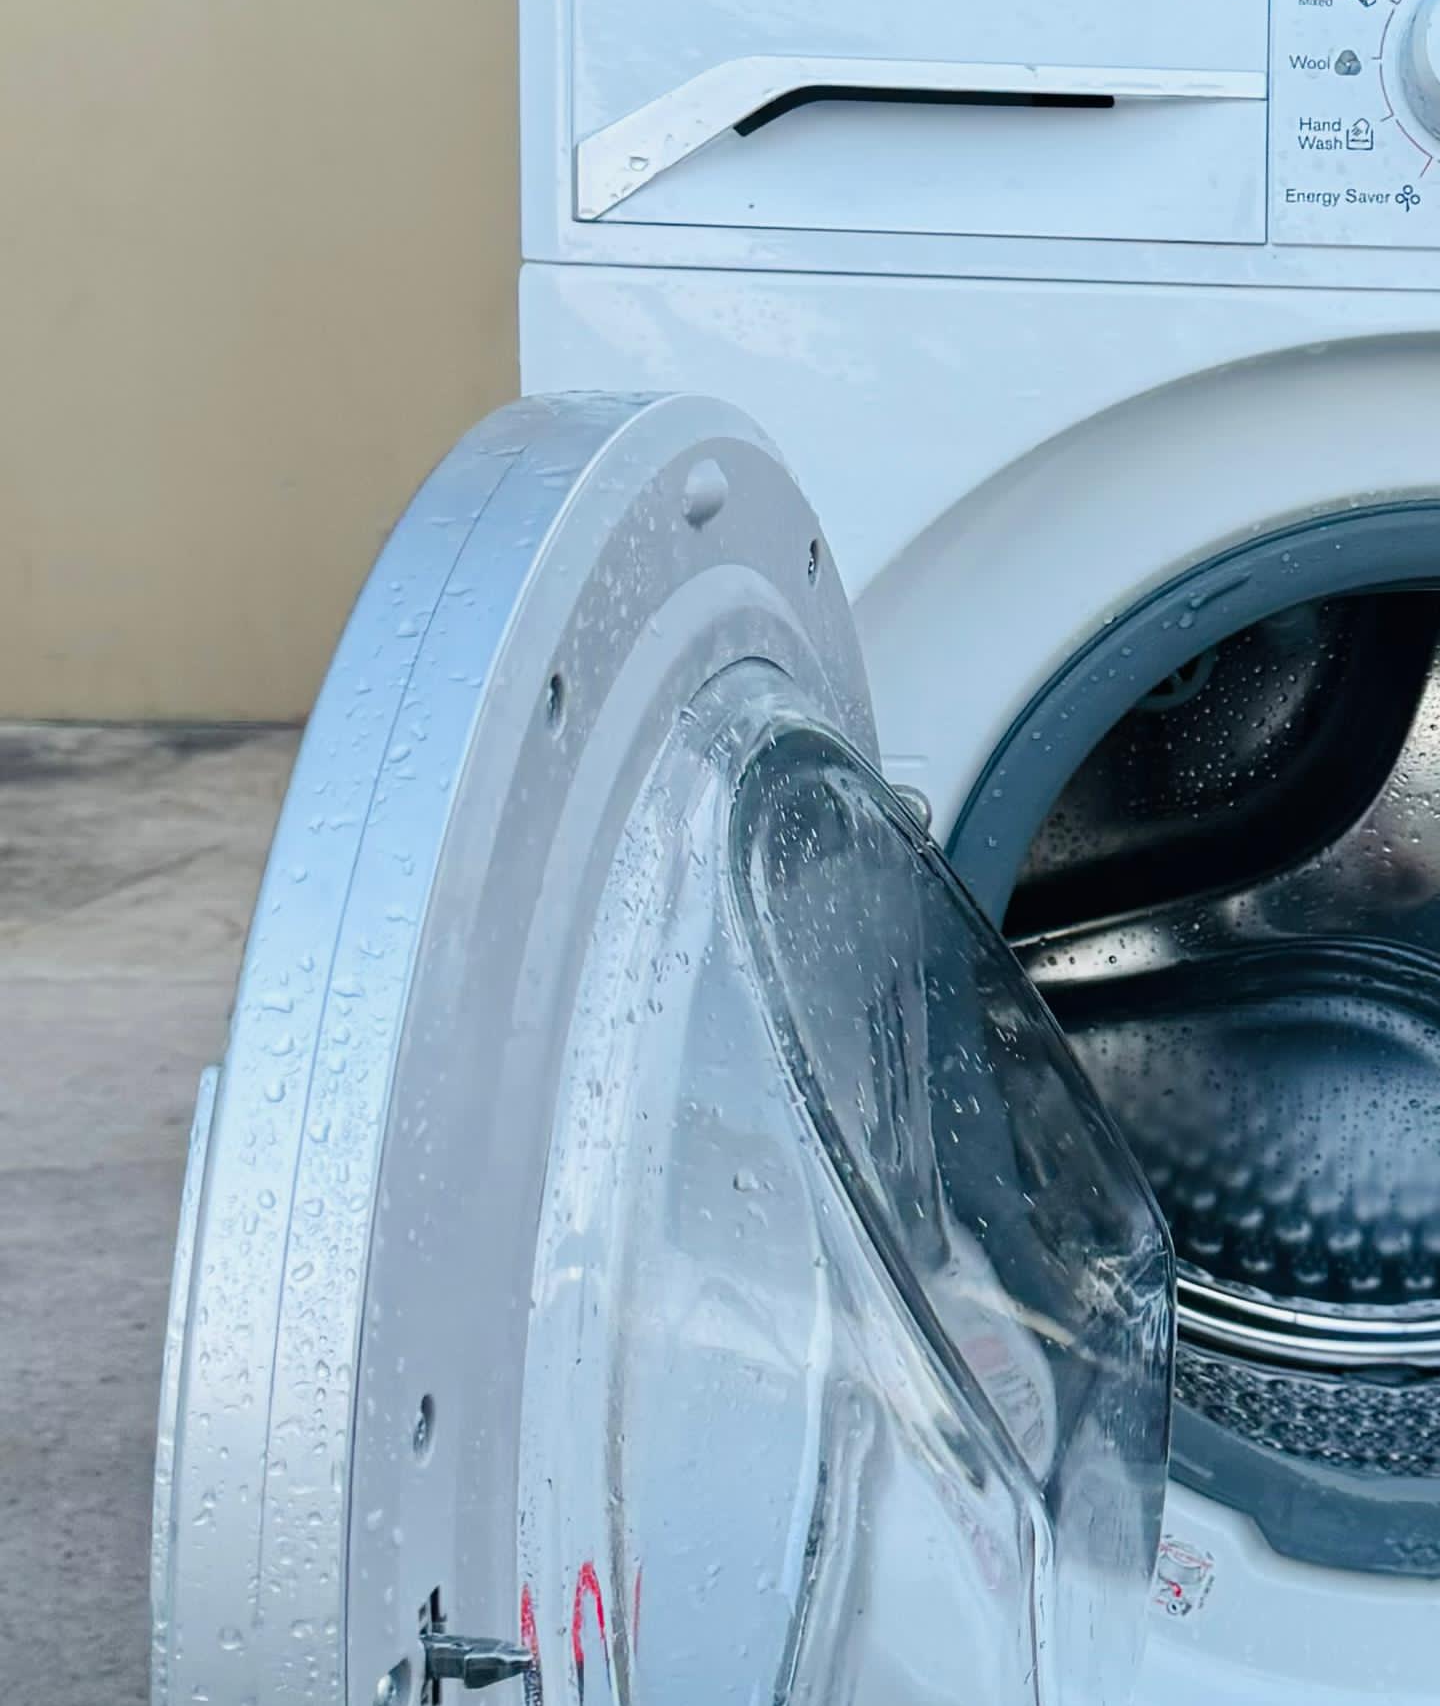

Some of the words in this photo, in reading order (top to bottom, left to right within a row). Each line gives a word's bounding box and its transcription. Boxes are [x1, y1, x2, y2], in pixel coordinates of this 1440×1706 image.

[1289, 54, 1331, 71] Wool
[1298, 116, 1342, 133] Hand
[1297, 135, 1343, 151] Wash
[1285, 188, 1340, 207] Energy
[1345, 189, 1391, 205] Saver
